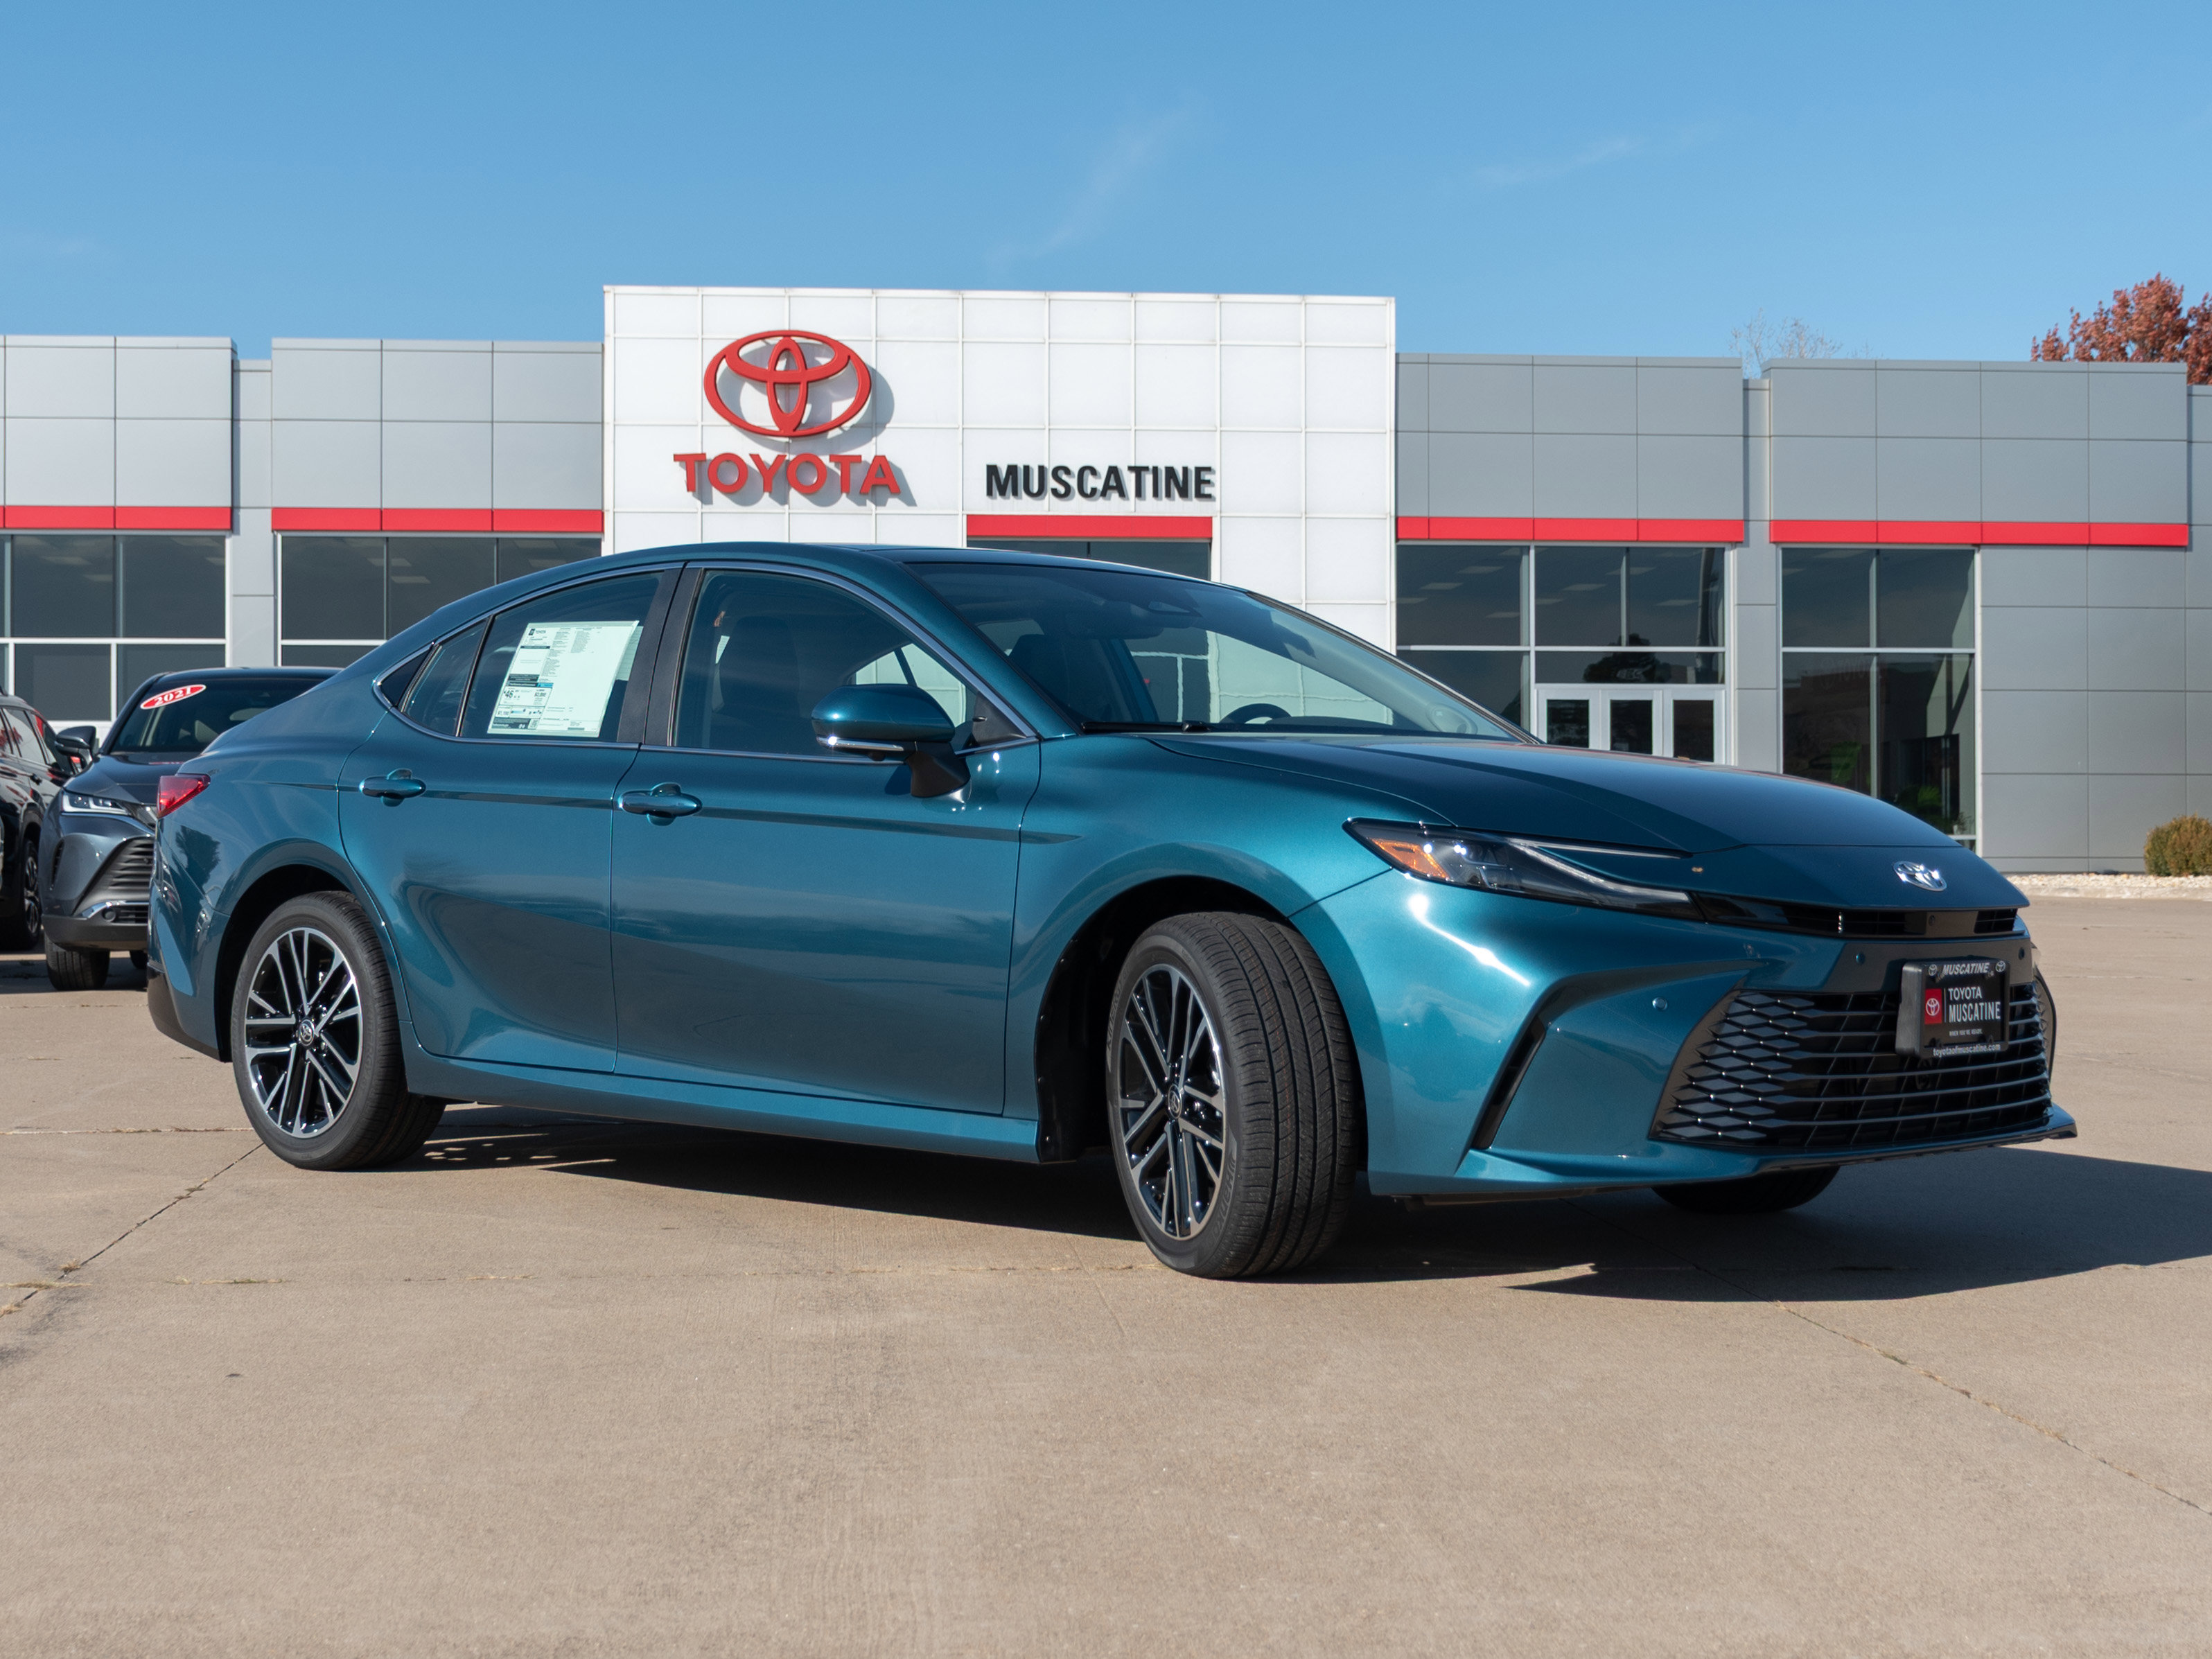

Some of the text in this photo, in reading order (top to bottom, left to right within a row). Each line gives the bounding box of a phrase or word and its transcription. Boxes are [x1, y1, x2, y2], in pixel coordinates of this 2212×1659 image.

[673, 453, 901, 495] TOYOTA
[985, 464, 1213, 500] MUSCATINE
[154, 687, 191, 706] 2021
[1942, 963, 1990, 975] MUSCATINE
[1949, 986, 1982, 1000] TOYOTA
[1949, 1001, 2001, 1022] MUSCATINE
[1933, 1044, 2001, 1057] toyotaofmuscatine.com
